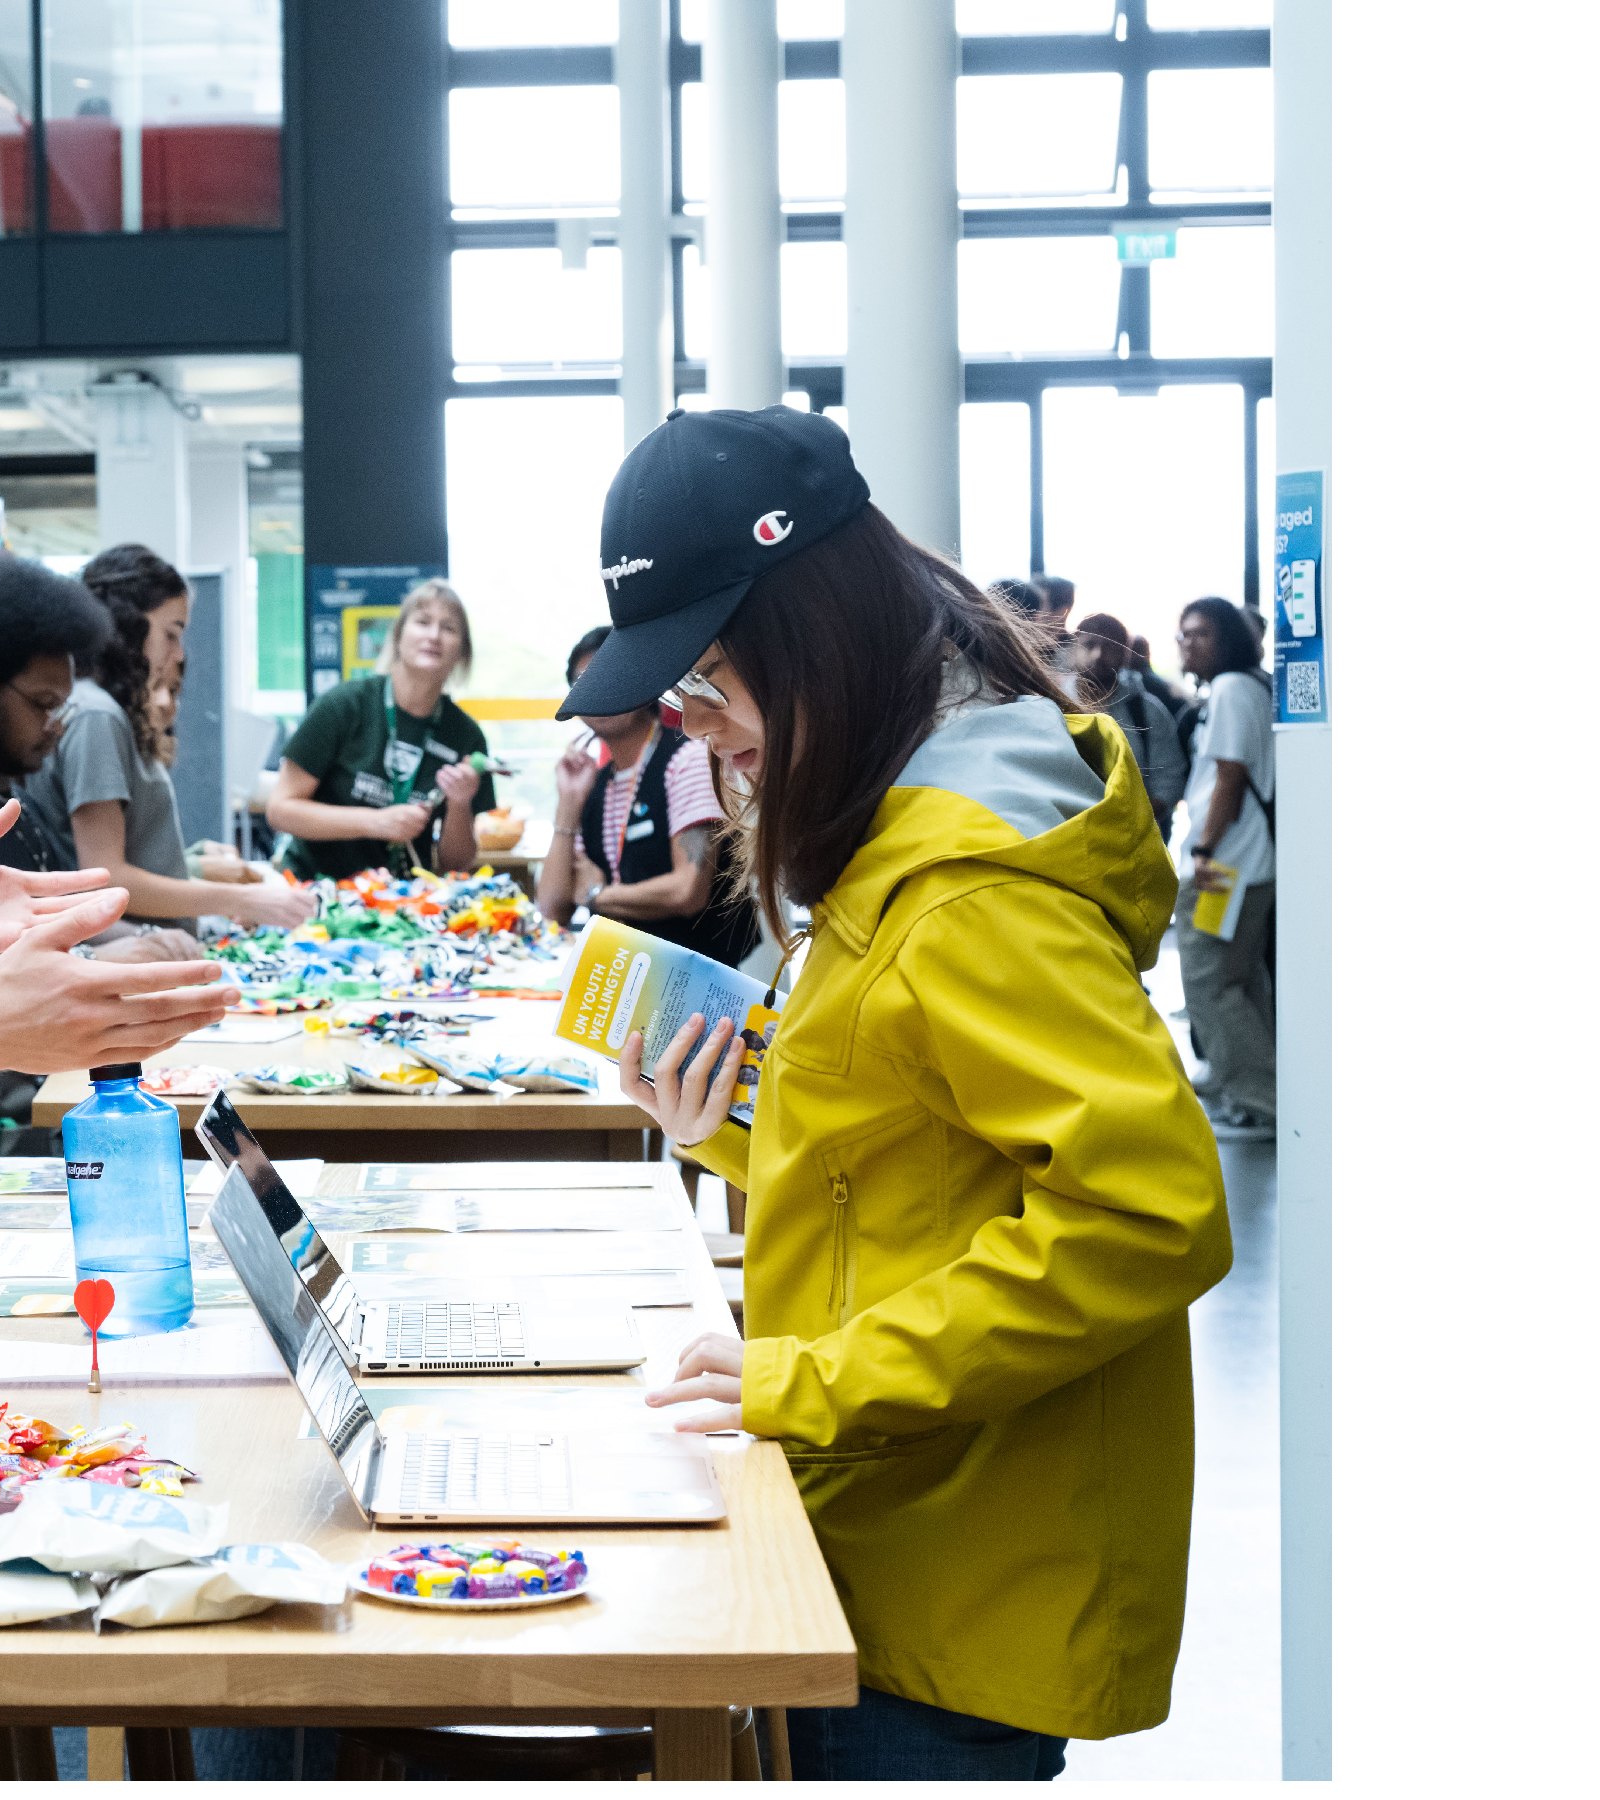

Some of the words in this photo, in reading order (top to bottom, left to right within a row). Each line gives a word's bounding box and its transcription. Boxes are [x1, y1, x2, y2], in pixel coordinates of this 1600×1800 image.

[1280, 505, 1313, 531] aged
[580, 963, 607, 1010] YOUTH
[588, 948, 629, 1040] WELLINGTON
[573, 1014, 590, 1035] UN
[615, 1011, 628, 1041] ABOUT
[624, 998, 632, 1009] US
[645, 1010, 660, 1041] MISSION
